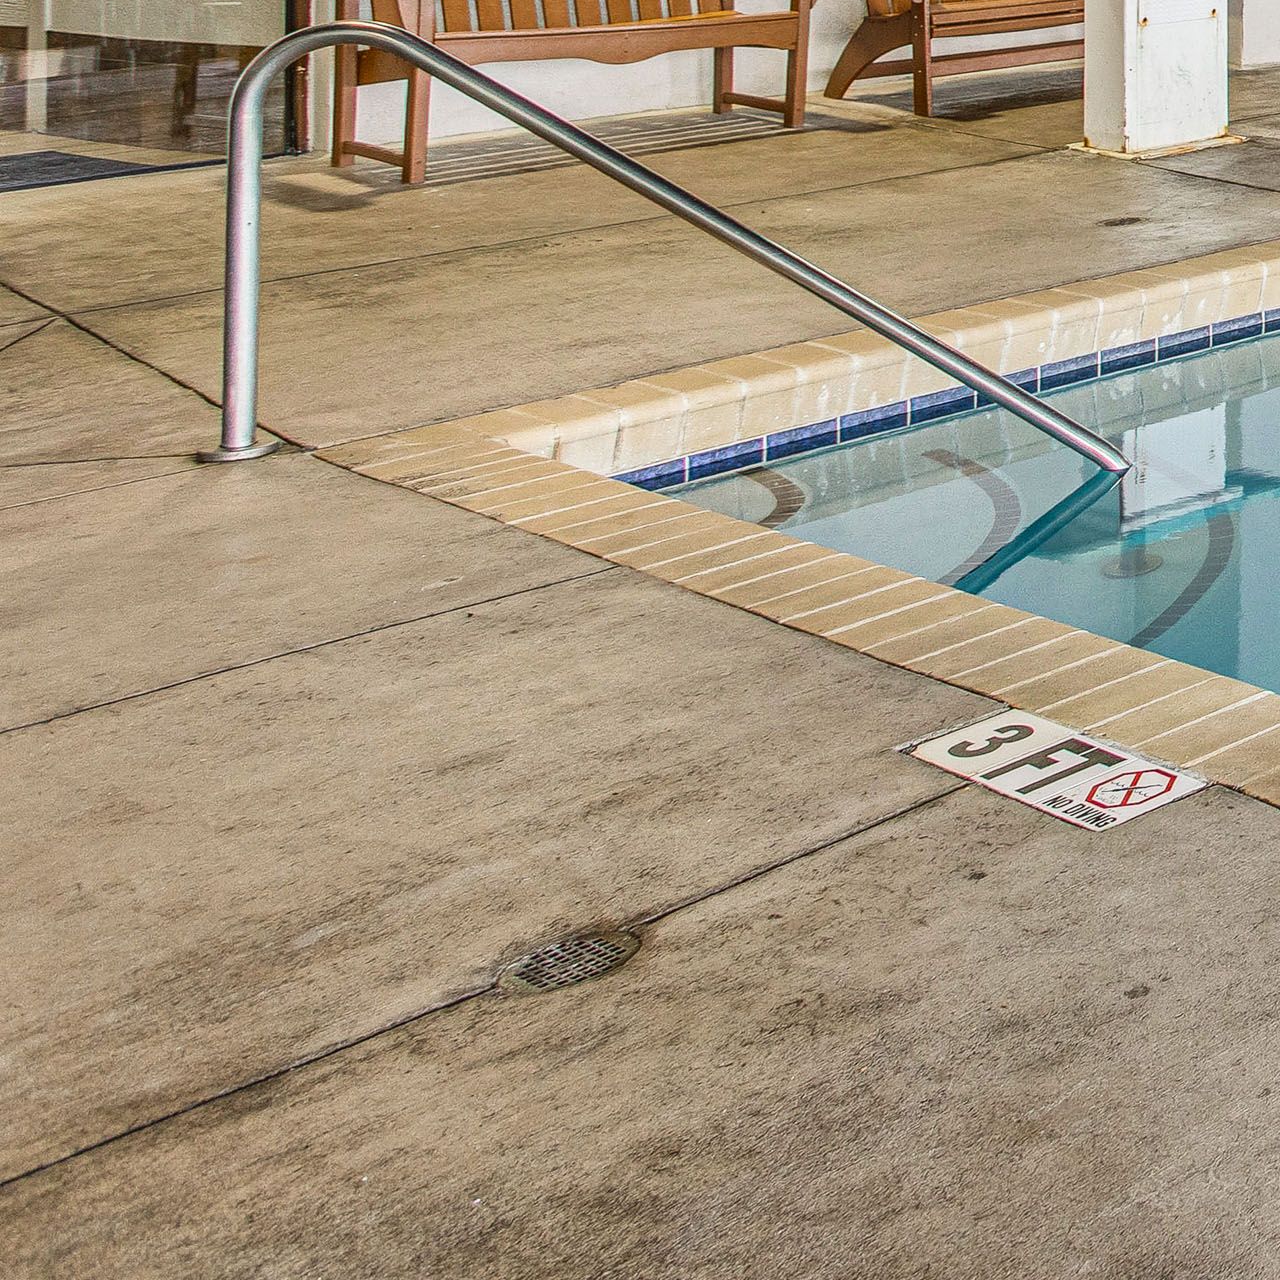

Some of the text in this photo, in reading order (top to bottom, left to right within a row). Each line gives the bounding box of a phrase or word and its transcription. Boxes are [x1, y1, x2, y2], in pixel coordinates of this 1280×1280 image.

[947, 724, 1128, 795] 3 FT
[1042, 795, 1117, 828] NO DIVING
